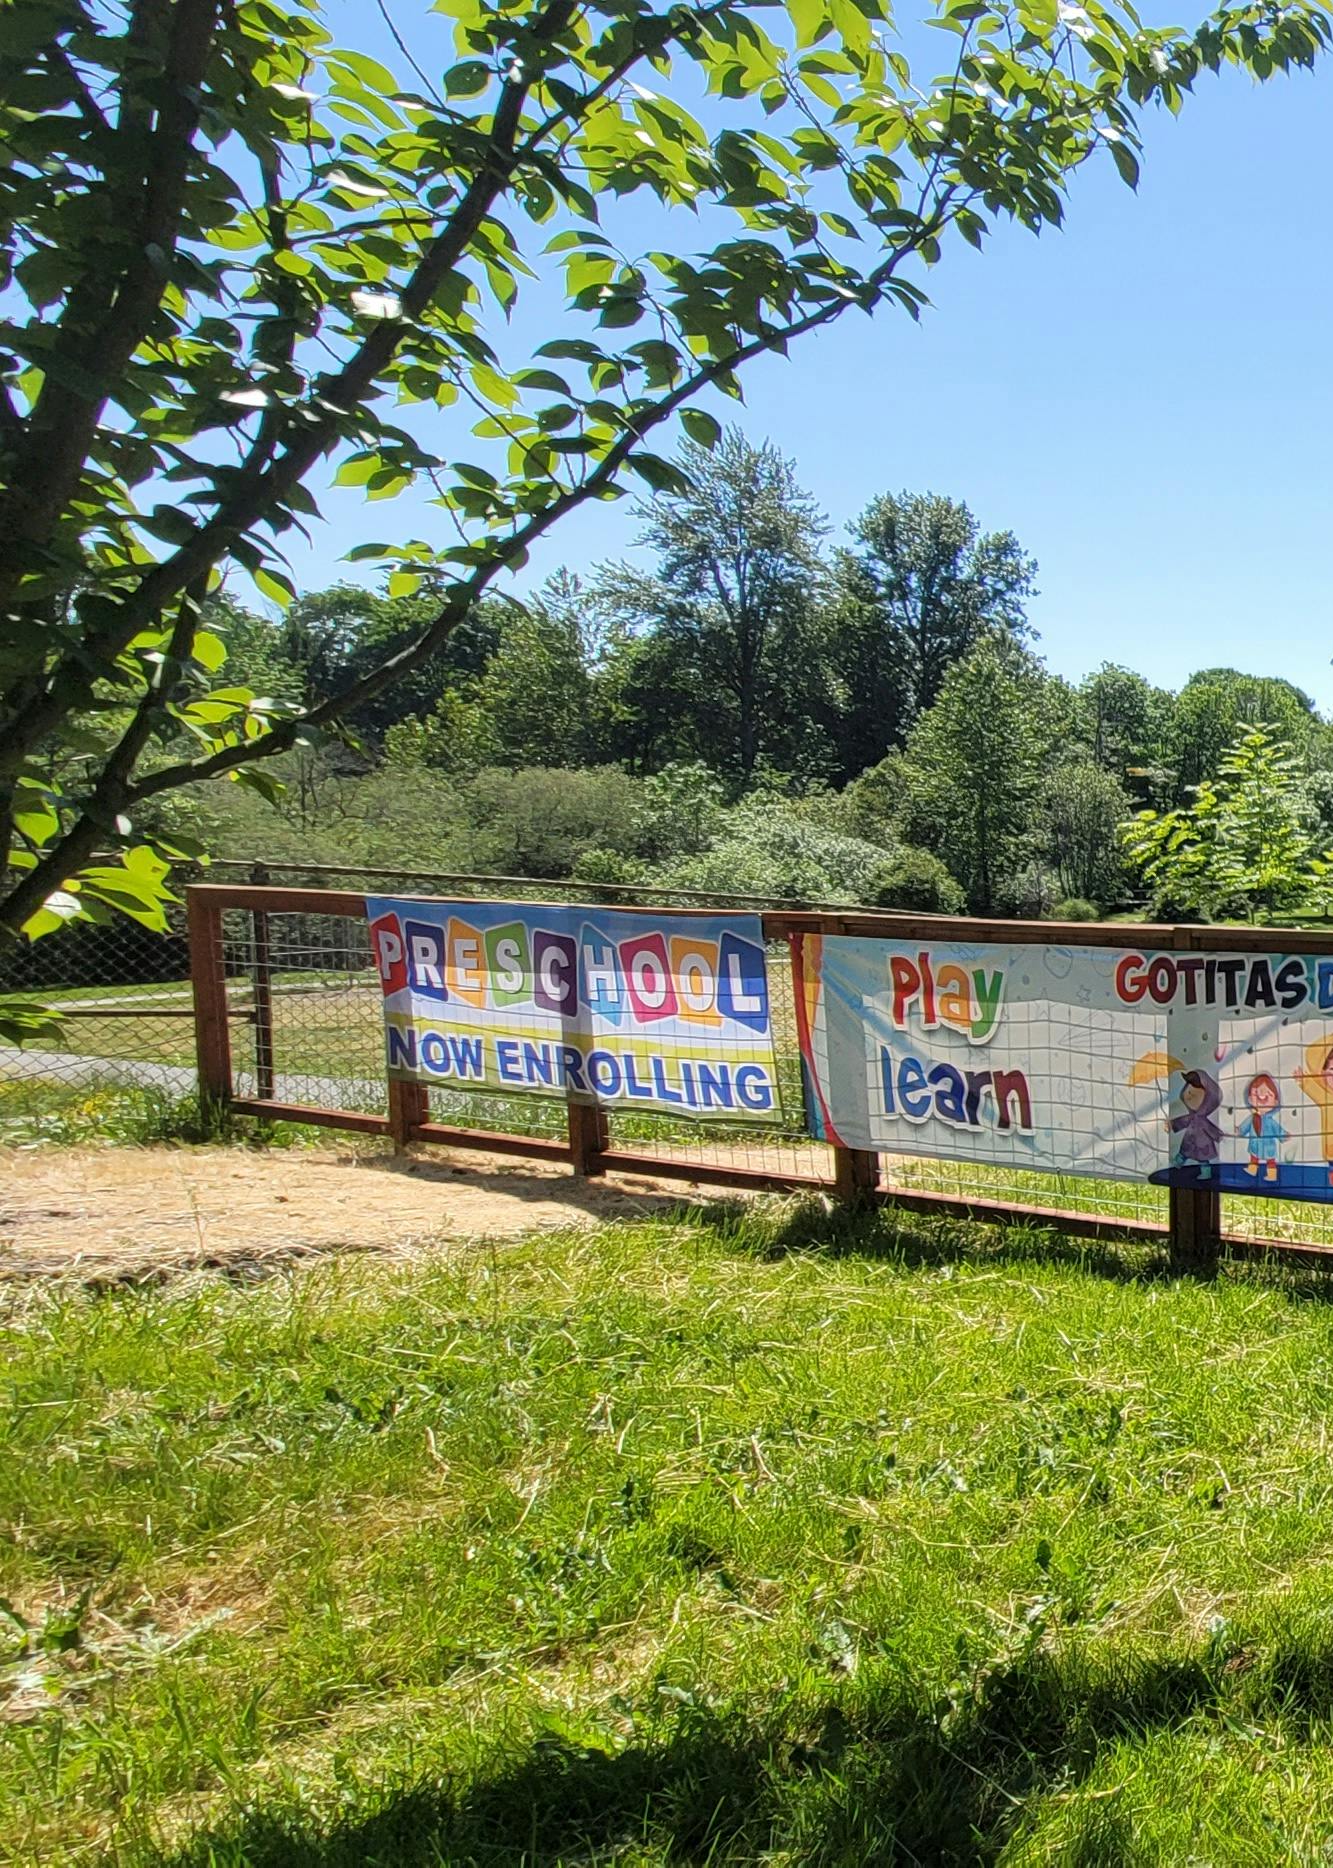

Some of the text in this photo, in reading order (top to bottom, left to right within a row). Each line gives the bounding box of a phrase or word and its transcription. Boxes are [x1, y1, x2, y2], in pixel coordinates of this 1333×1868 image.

[378, 930, 763, 1013] PRESCHOOL
[890, 952, 1004, 1039] Play
[1115, 954, 1306, 1010] GOTITAS
[390, 1027, 771, 1110] NOW ENROLLING
[880, 1045, 1032, 1129] learn
